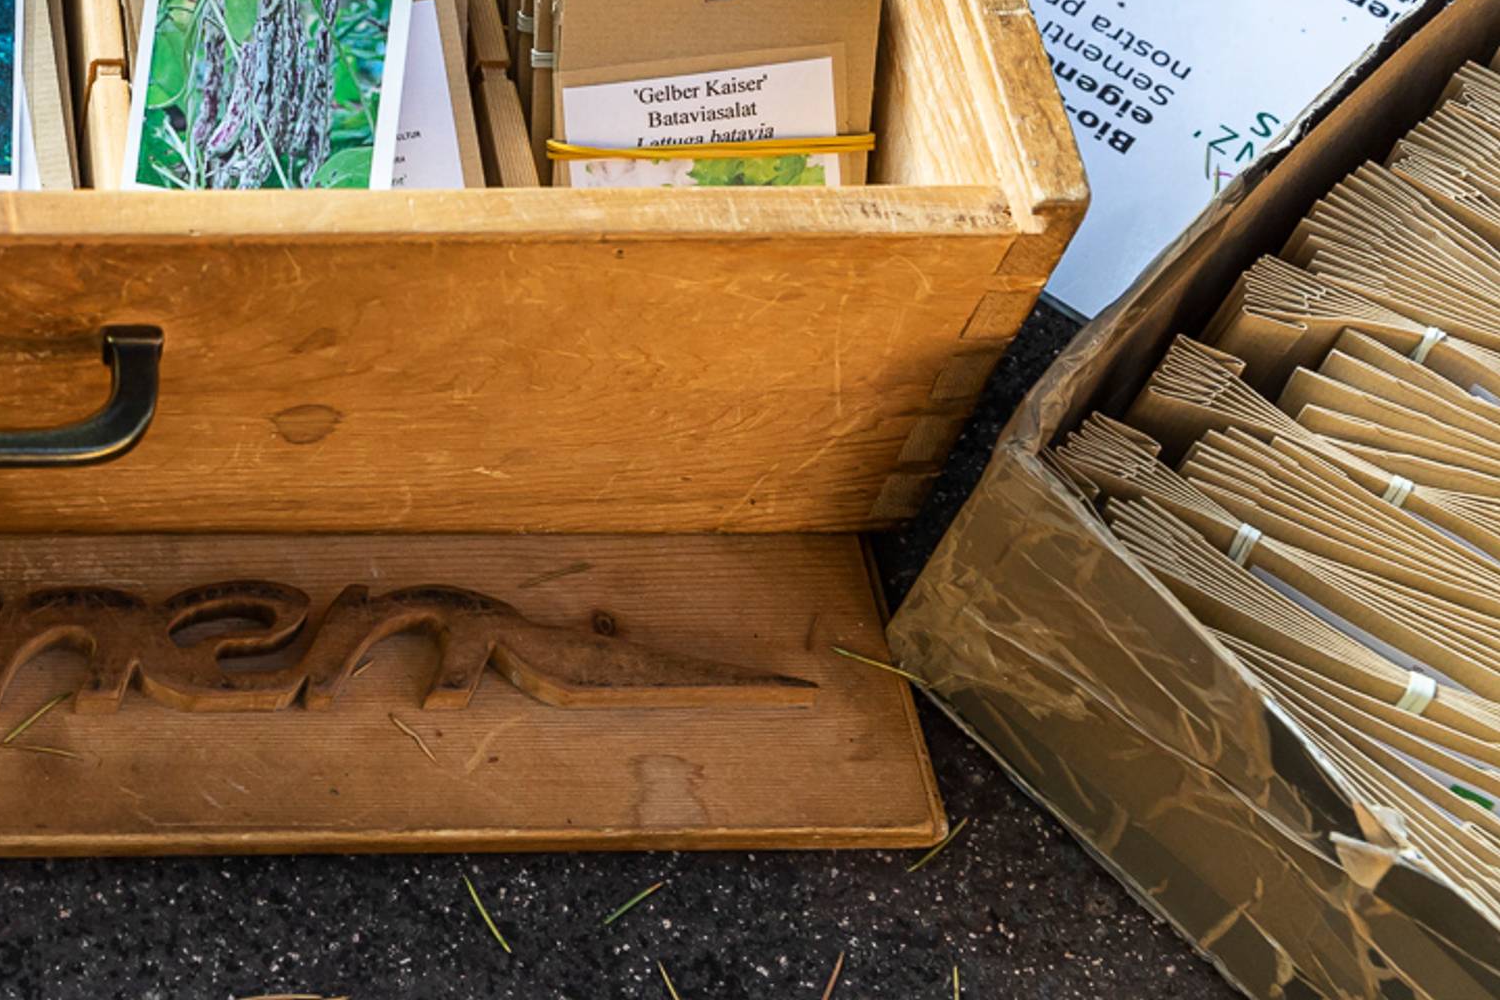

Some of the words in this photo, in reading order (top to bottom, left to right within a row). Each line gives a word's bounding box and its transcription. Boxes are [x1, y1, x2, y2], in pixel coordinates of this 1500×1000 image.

[1041, 19, 1176, 108] Sementi
[1090, 13, 1193, 82] nostra
[633, 84, 701, 106] 'Gelber
[705, 73, 769, 98] Kaiser'
[647, 101, 758, 129] Bataviasalat
